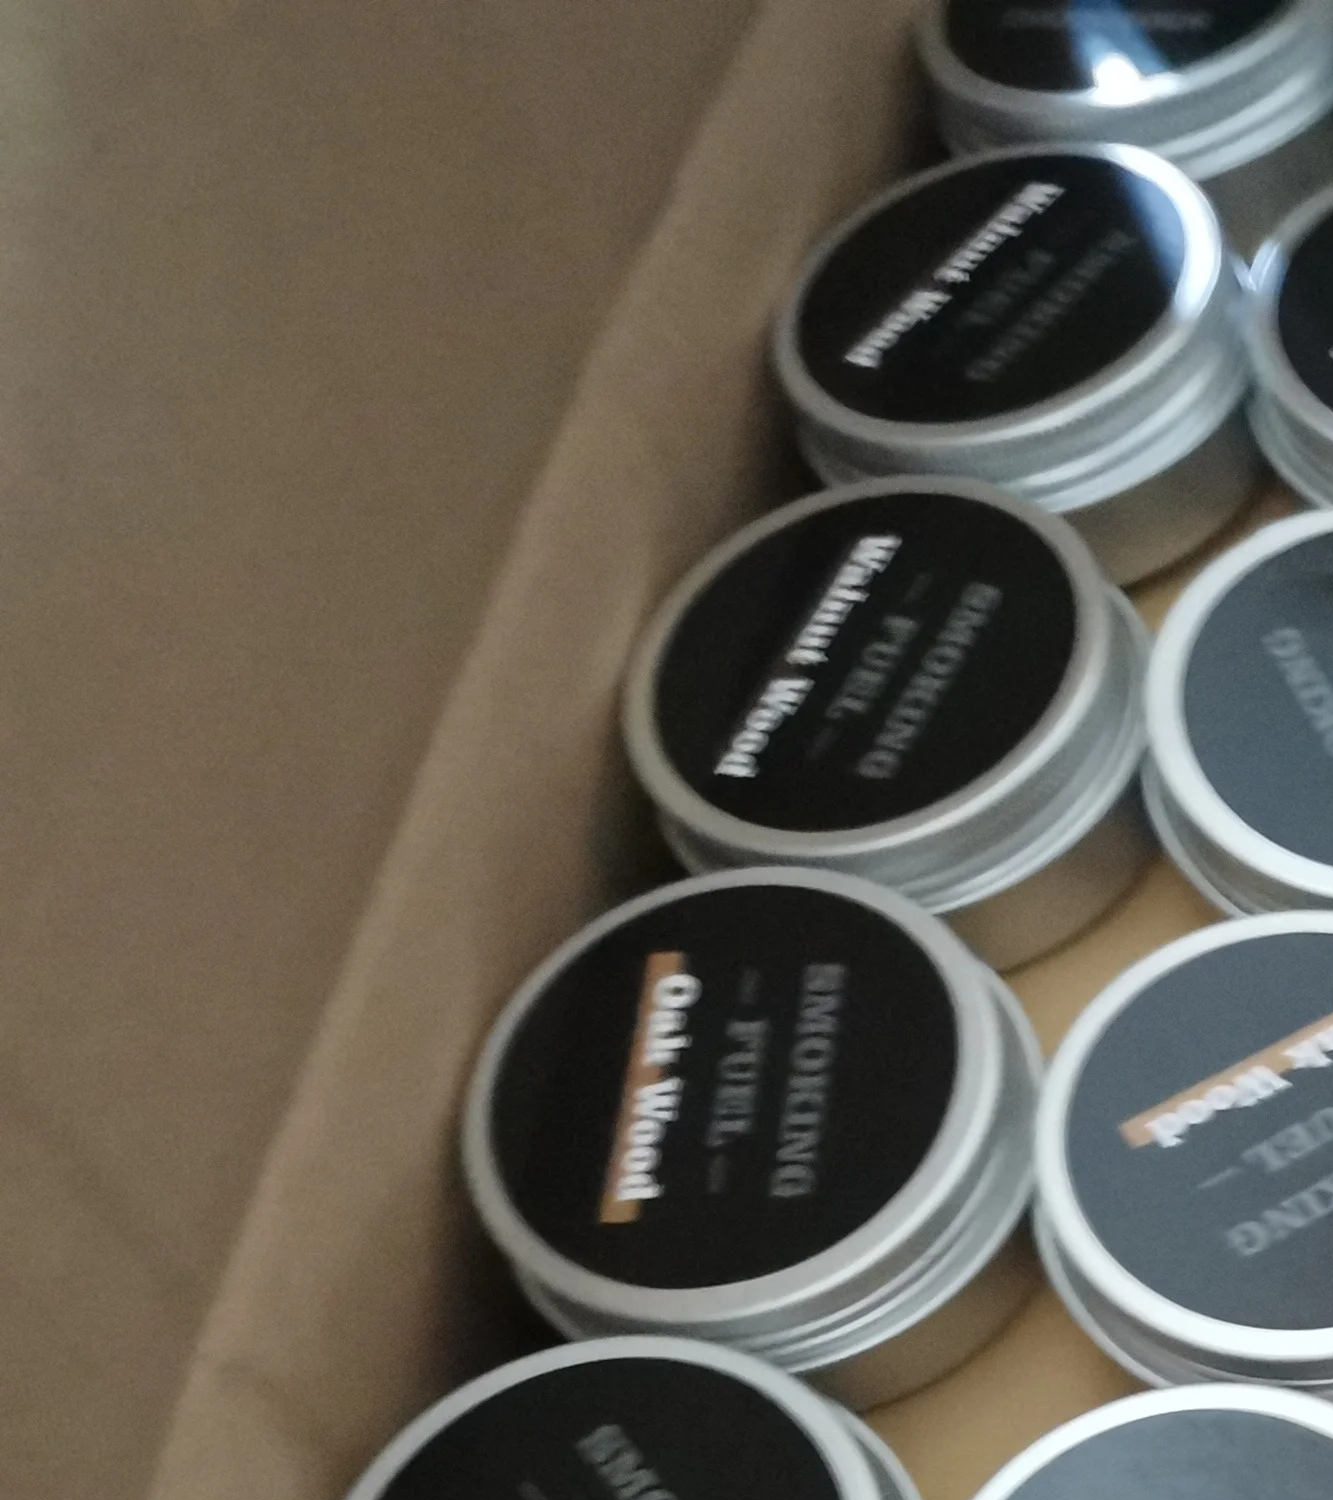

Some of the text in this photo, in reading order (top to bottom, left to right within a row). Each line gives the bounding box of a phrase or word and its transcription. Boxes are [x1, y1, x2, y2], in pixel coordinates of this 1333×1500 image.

[613, 971, 703, 1202] Oak Wood
[1146, 1066, 1294, 1149] Wood
